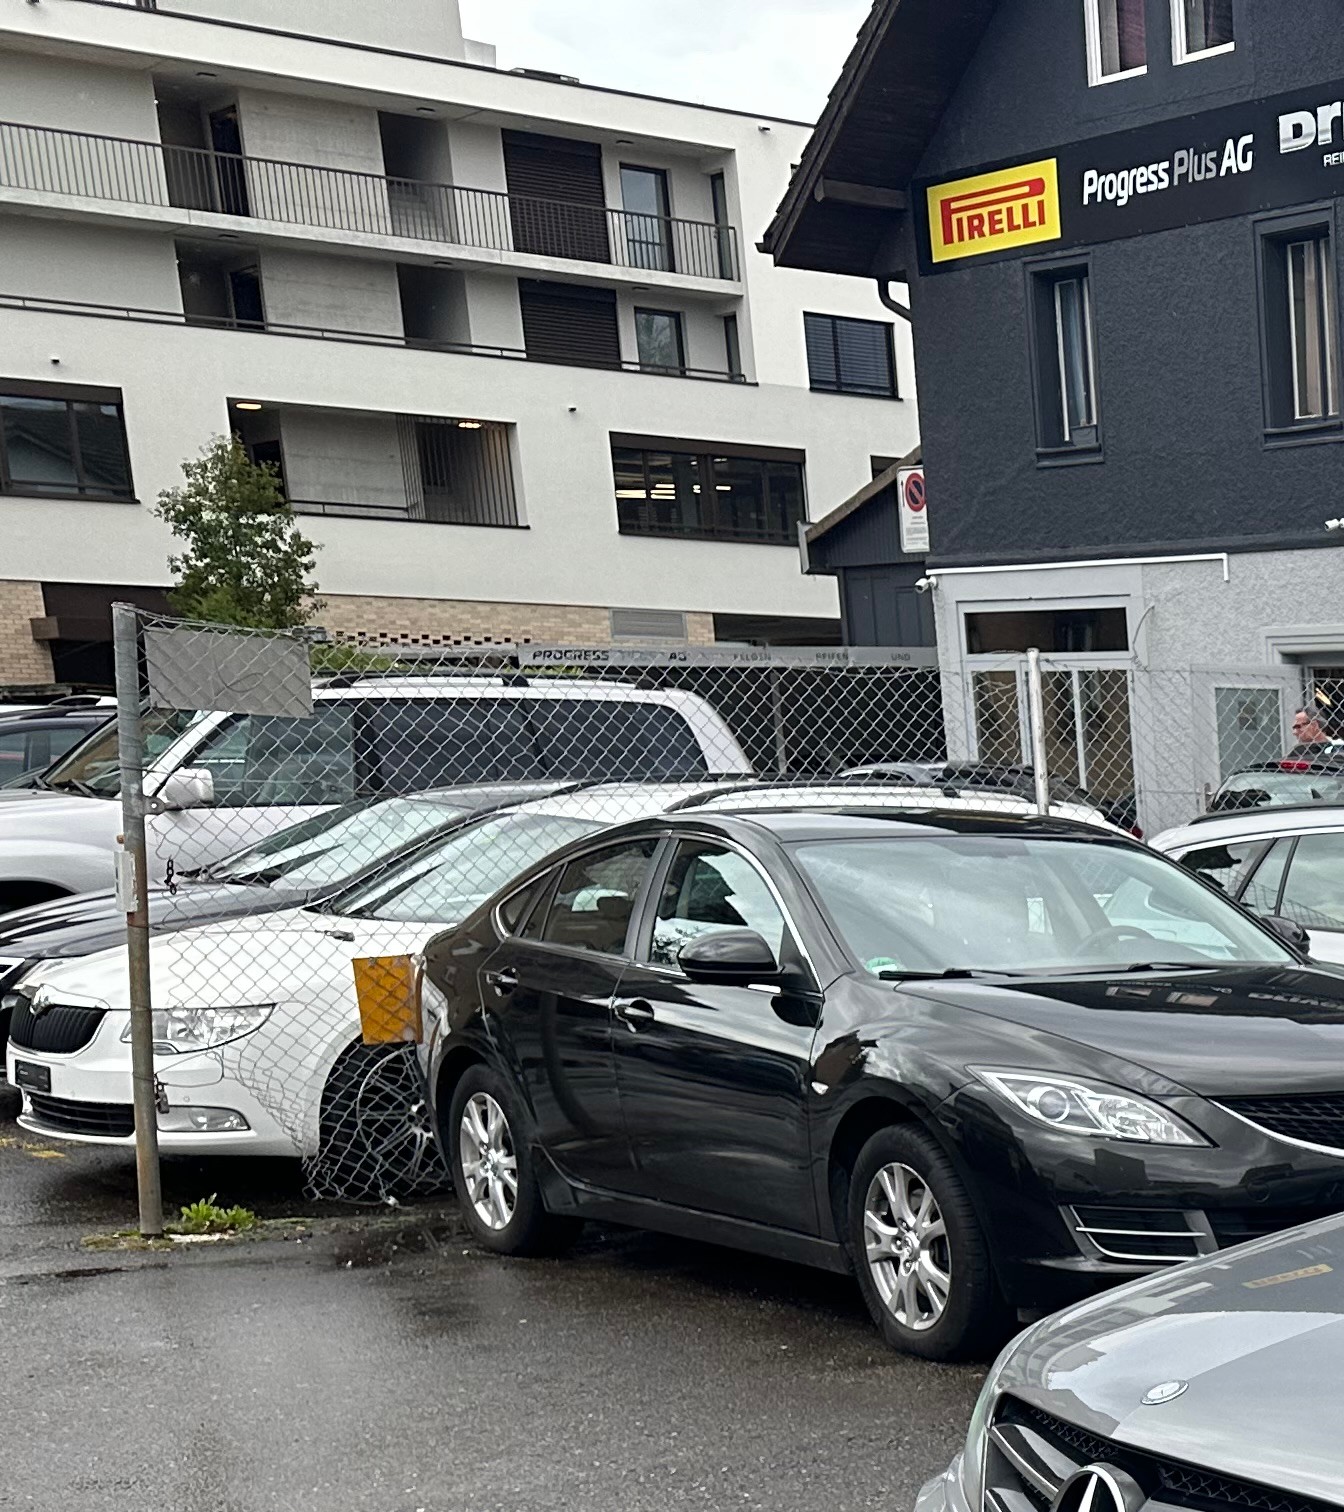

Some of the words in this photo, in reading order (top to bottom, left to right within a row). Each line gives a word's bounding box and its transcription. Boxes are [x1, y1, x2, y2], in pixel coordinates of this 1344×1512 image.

[1082, 160, 1170, 207] Progress
[1173, 147, 1217, 186] Plus
[1219, 133, 1254, 177] AG
[940, 177, 1046, 246] PIRELLI
[532, 649, 610, 661] PROGRESS
